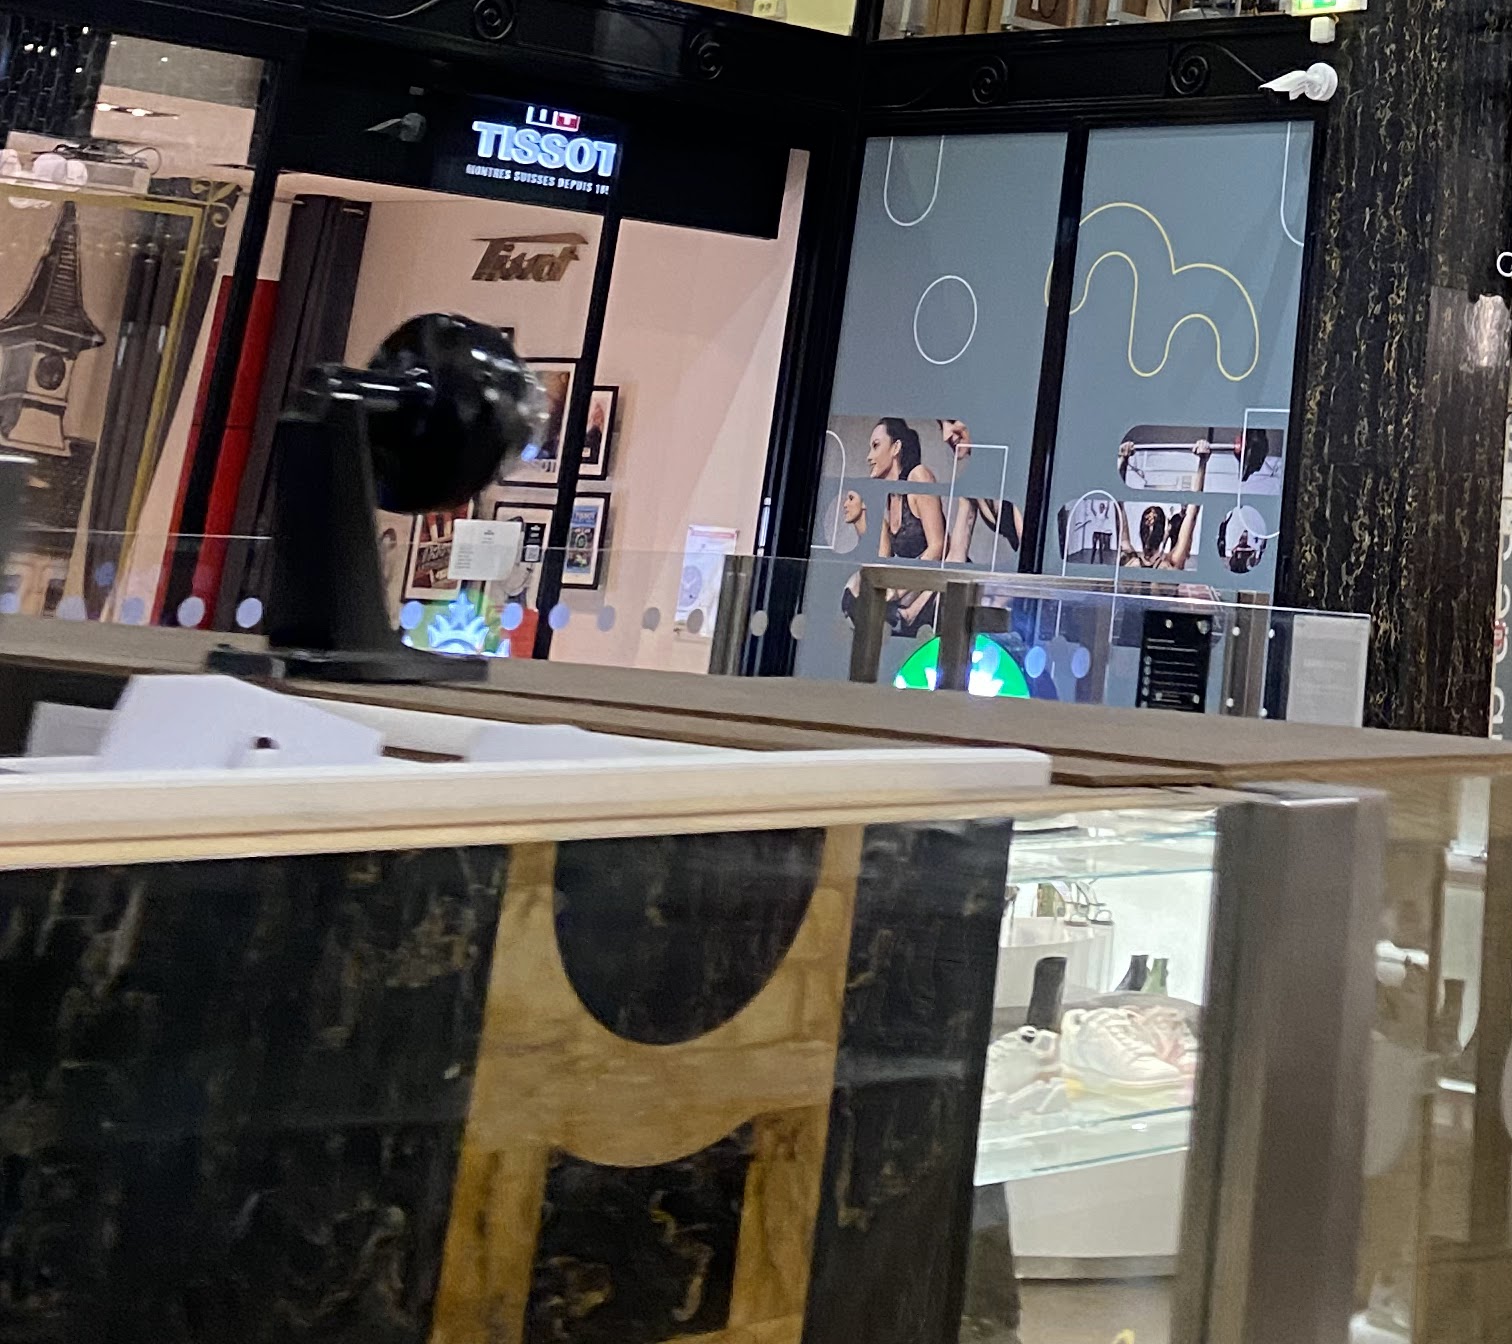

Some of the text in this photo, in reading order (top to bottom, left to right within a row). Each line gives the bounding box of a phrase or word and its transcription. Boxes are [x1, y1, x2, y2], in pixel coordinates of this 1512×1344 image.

[472, 120, 618, 178] TISSOT
[465, 163, 512, 181] MONTRES
[513, 170, 556, 187] SUISSES
[557, 177, 593, 194] DEPUIS
